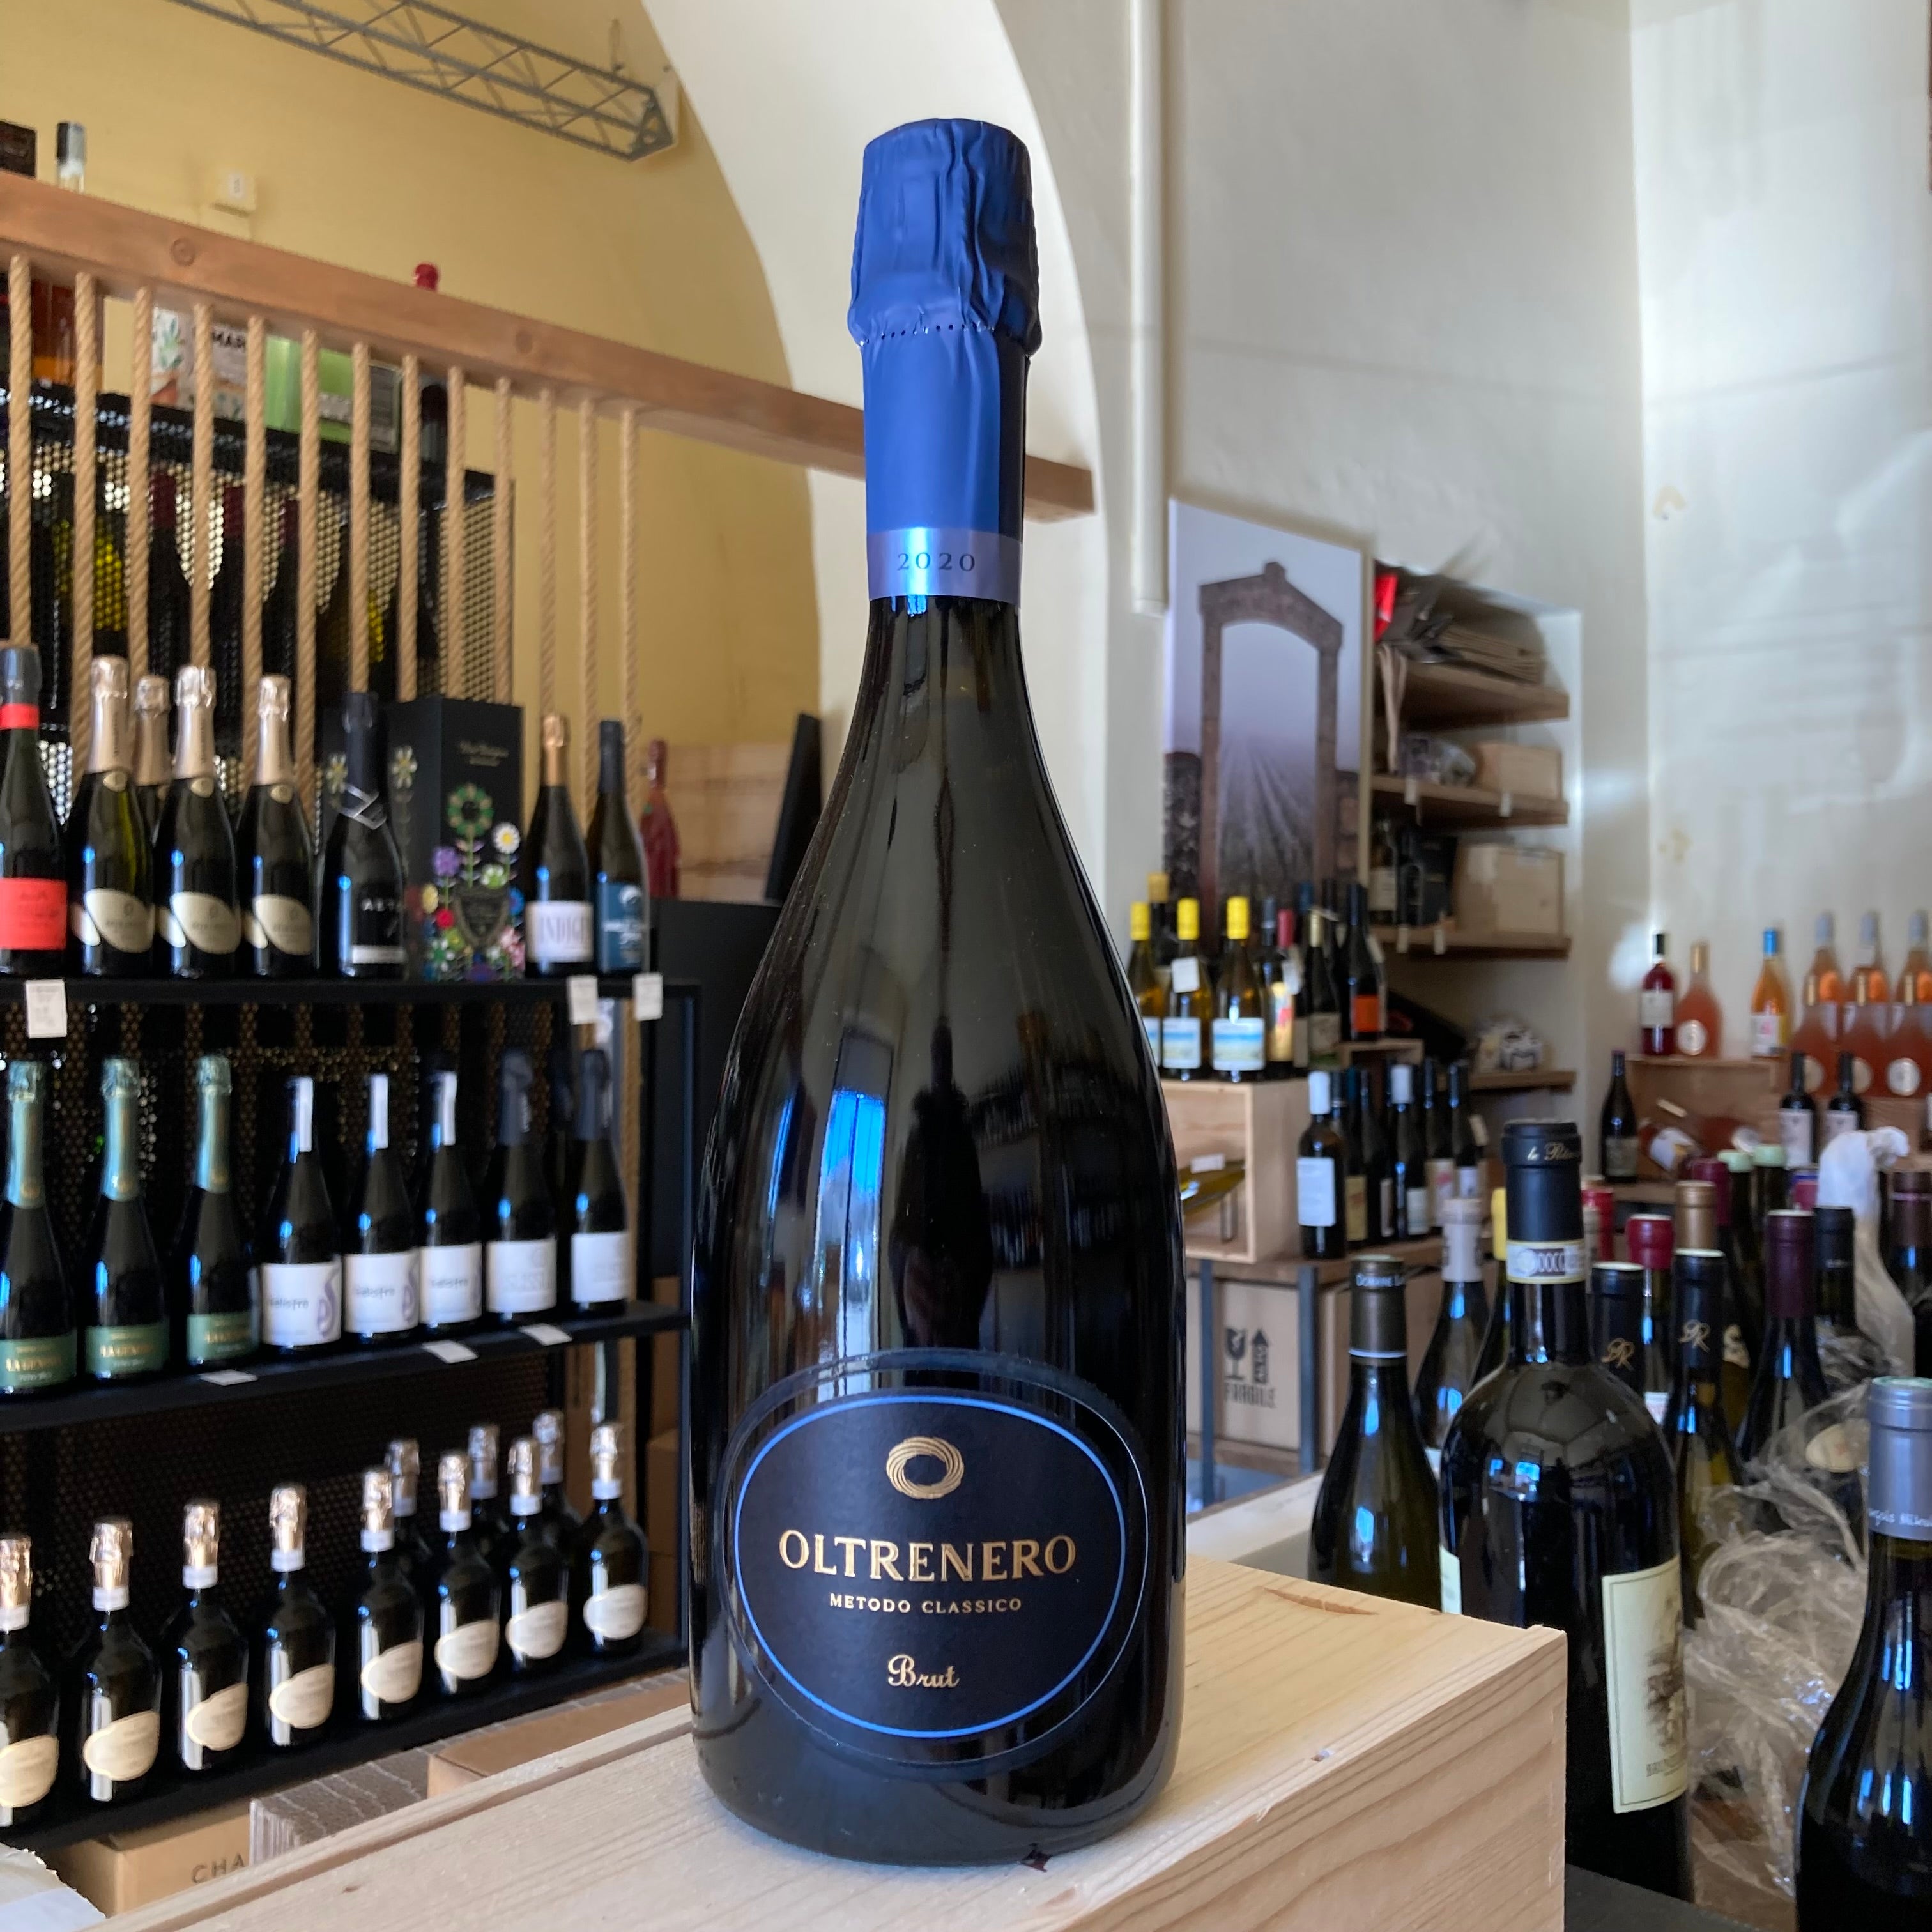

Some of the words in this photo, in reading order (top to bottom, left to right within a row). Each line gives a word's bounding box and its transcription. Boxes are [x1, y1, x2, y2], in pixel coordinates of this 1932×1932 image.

[897, 551, 976, 572] 2020
[779, 1529, 1077, 1583] OLTRENERO
[830, 1593, 911, 1614] METODO
[922, 1597, 1022, 1614] CLASSICO
[887, 1653, 960, 1689] Brut
